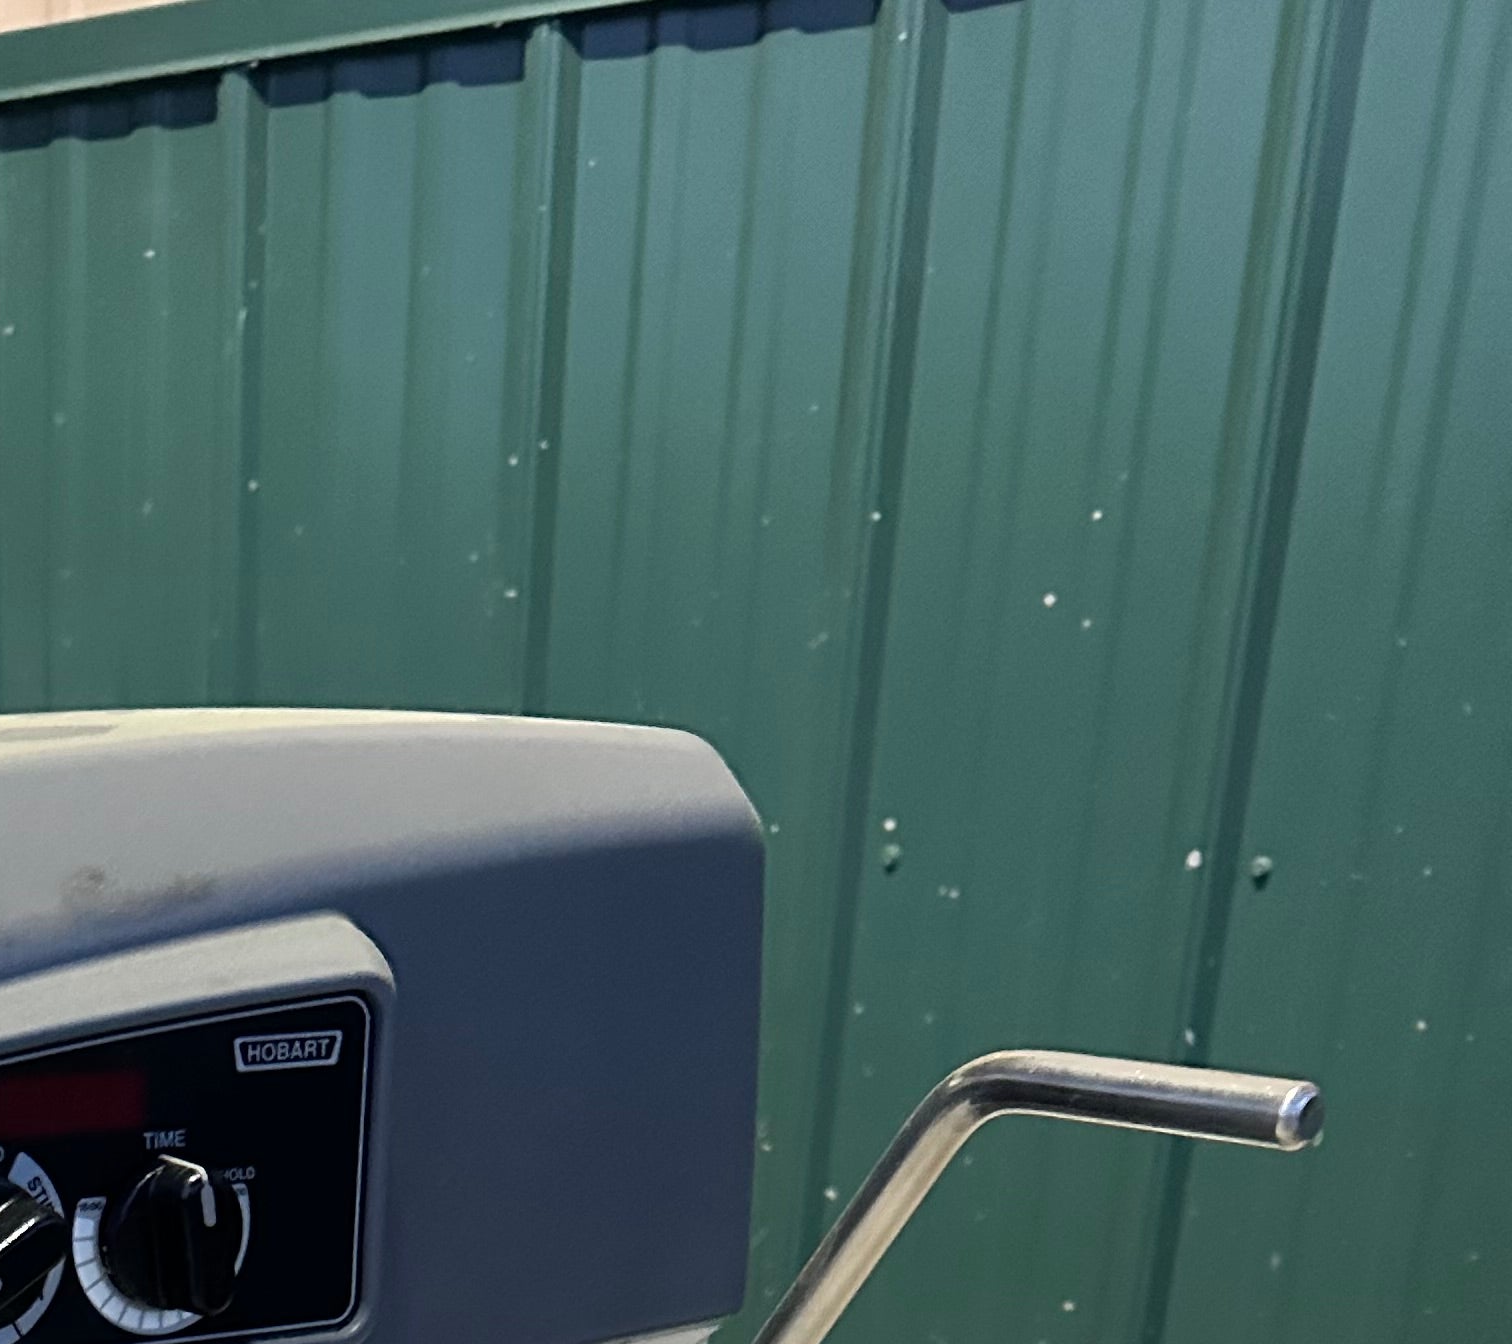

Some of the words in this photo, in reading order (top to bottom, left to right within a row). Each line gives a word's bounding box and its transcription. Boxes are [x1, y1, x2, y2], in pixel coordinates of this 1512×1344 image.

[246, 1038, 330, 1063] HOBART
[143, 1129, 187, 1150] TIME
[27, 1176, 53, 1208] STI
